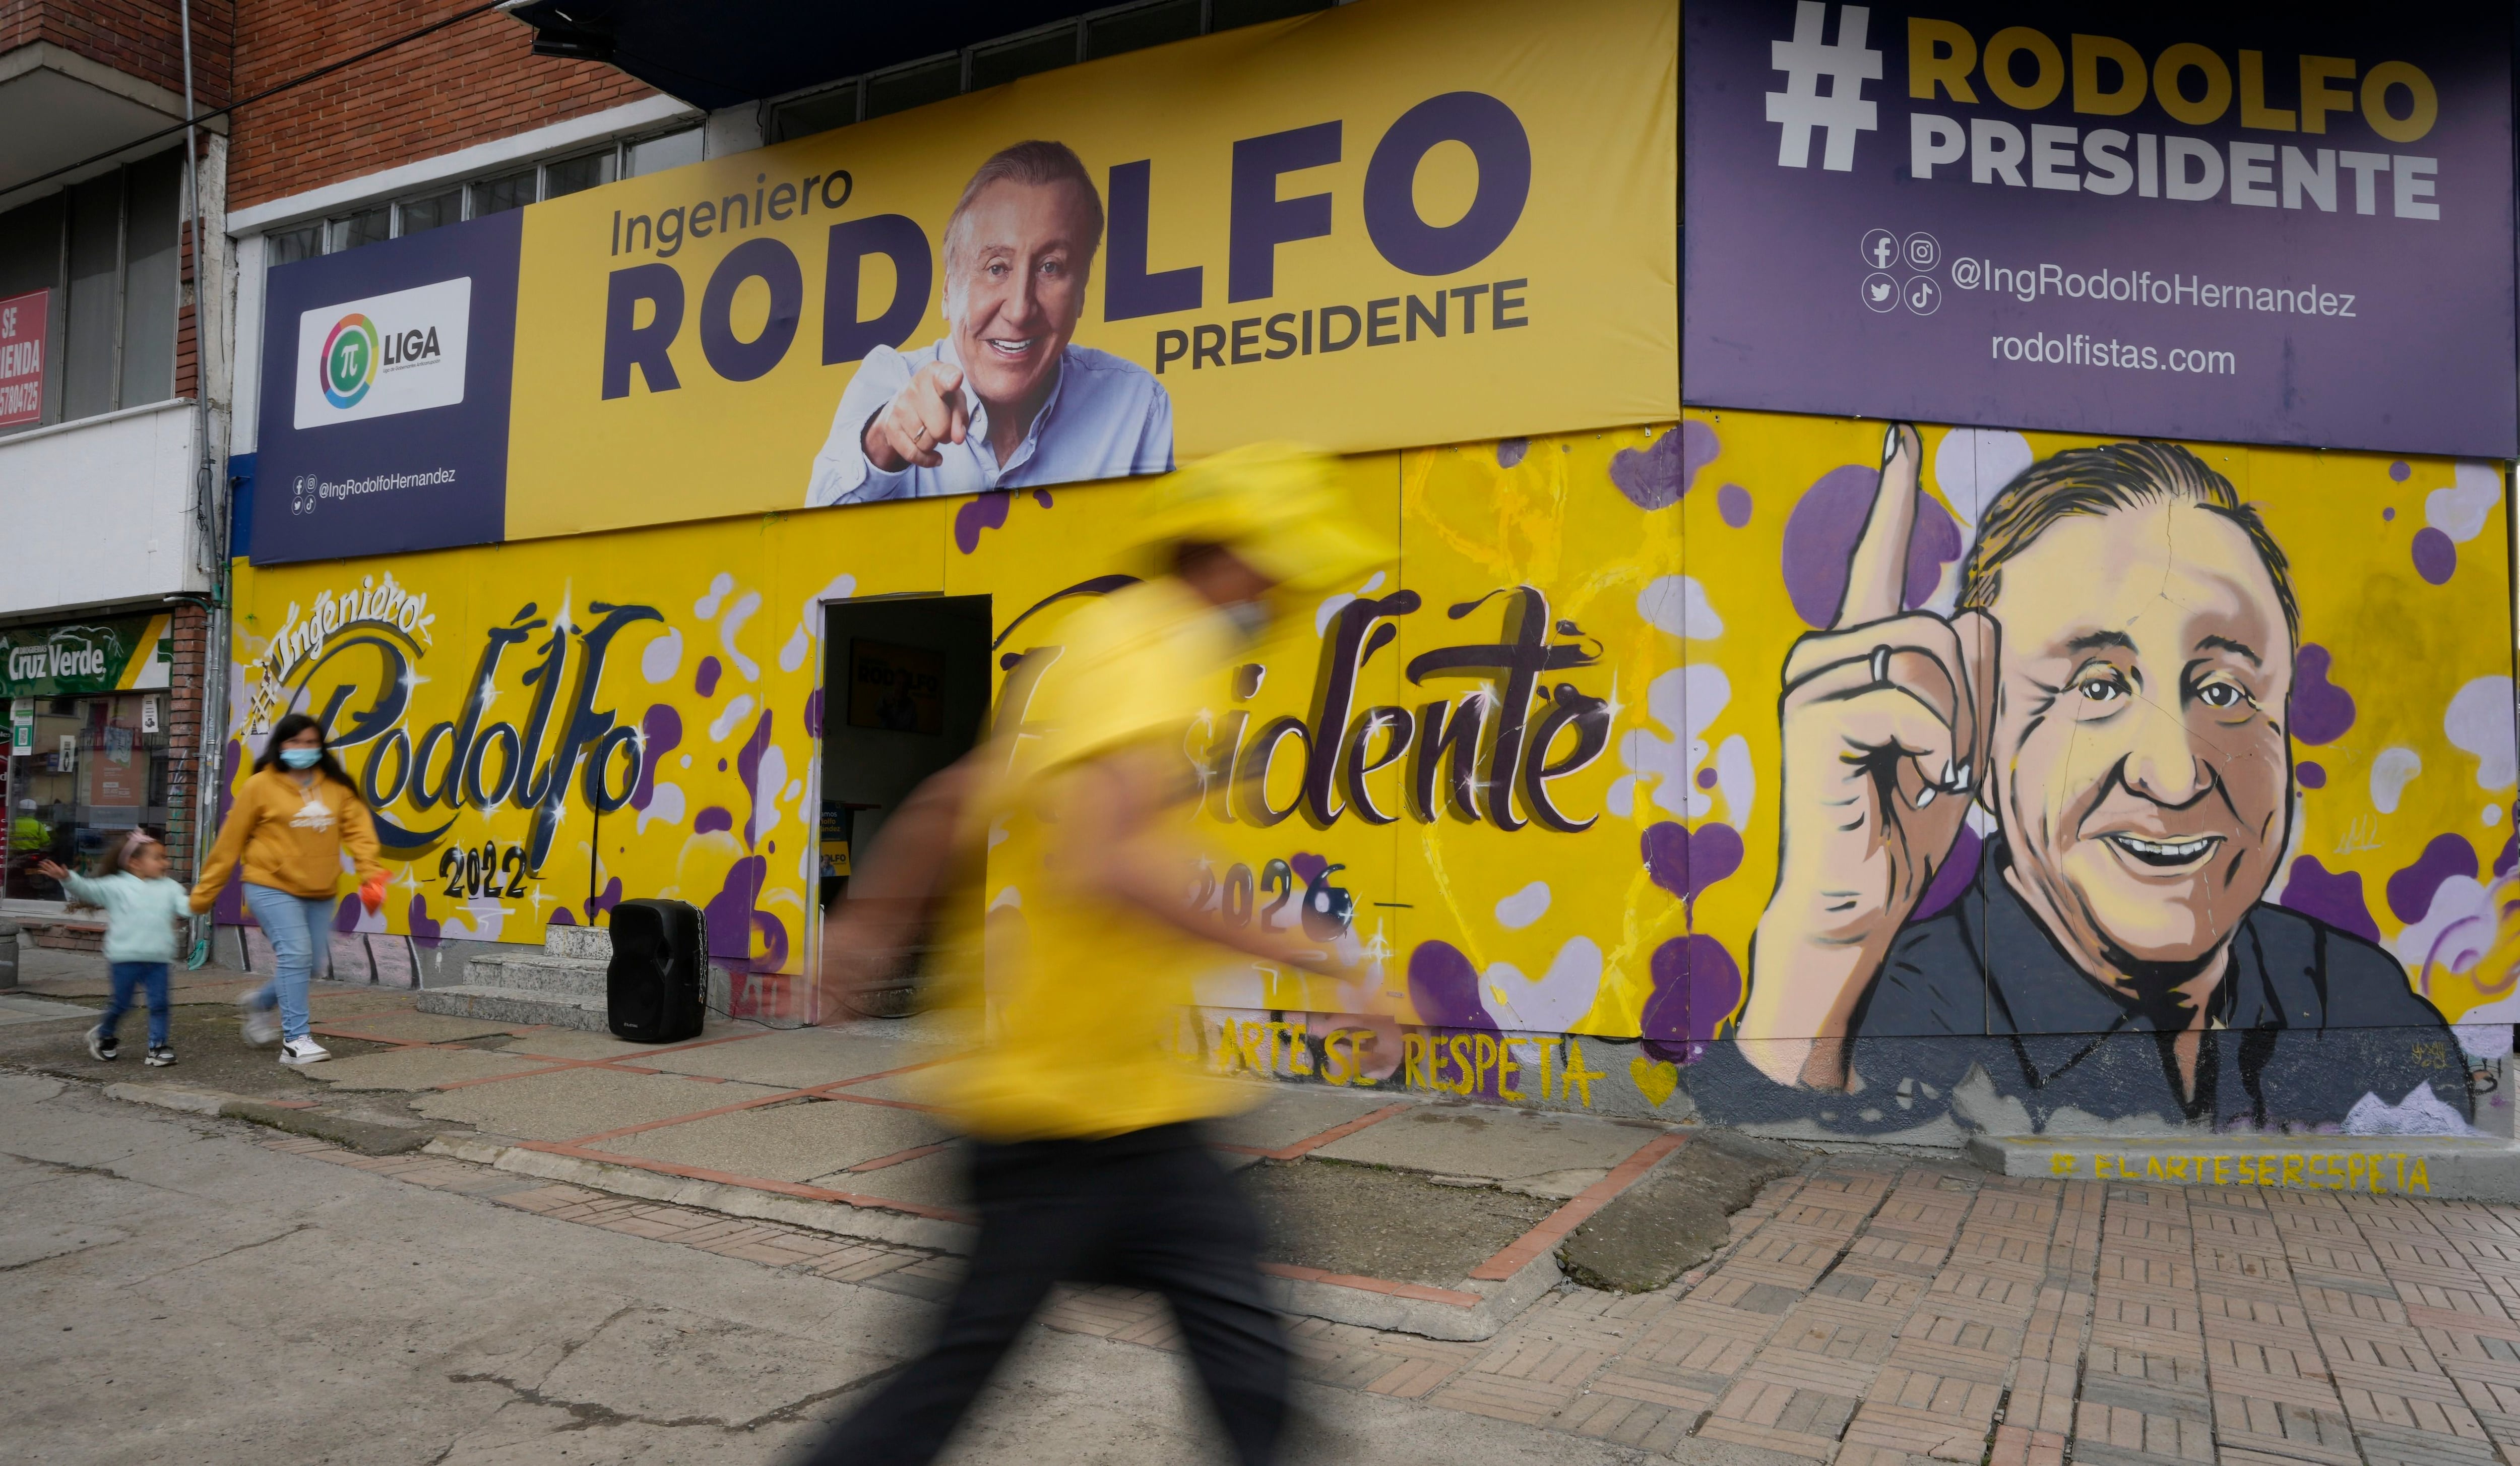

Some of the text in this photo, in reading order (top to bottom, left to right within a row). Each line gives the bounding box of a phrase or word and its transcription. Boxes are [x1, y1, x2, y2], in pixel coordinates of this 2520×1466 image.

[1908, 17, 2438, 143] RODOLFO
[1910, 112, 2440, 221] PRESIDENTE
[611, 169, 853, 258] Ingeniero
[602, 91, 1531, 401] RODLFO
[1951, 257, 2357, 318] @IngRodolfoHernandez
[2, 307, 17, 339] SE
[384, 326, 440, 365] LIGA
[1156, 278, 1528, 374] PRESIDENTE
[1991, 332, 2236, 375] rodolfistas.com
[0, 339, 40, 380] IENDA
[319, 467, 455, 500] @IngRodolfoHernandez
[265, 571, 426, 682] Ingeniero
[9, 647, 47, 681] Cruz
[858, 665, 936, 691] RODLFO
[438, 840, 528, 899] 2022
[1187, 859, 1353, 942] 2026
[1216, 1016, 1312, 1076] ARTE
[1320, 1030, 1377, 1086] SE
[1405, 1031, 1606, 1108] RESPETA
